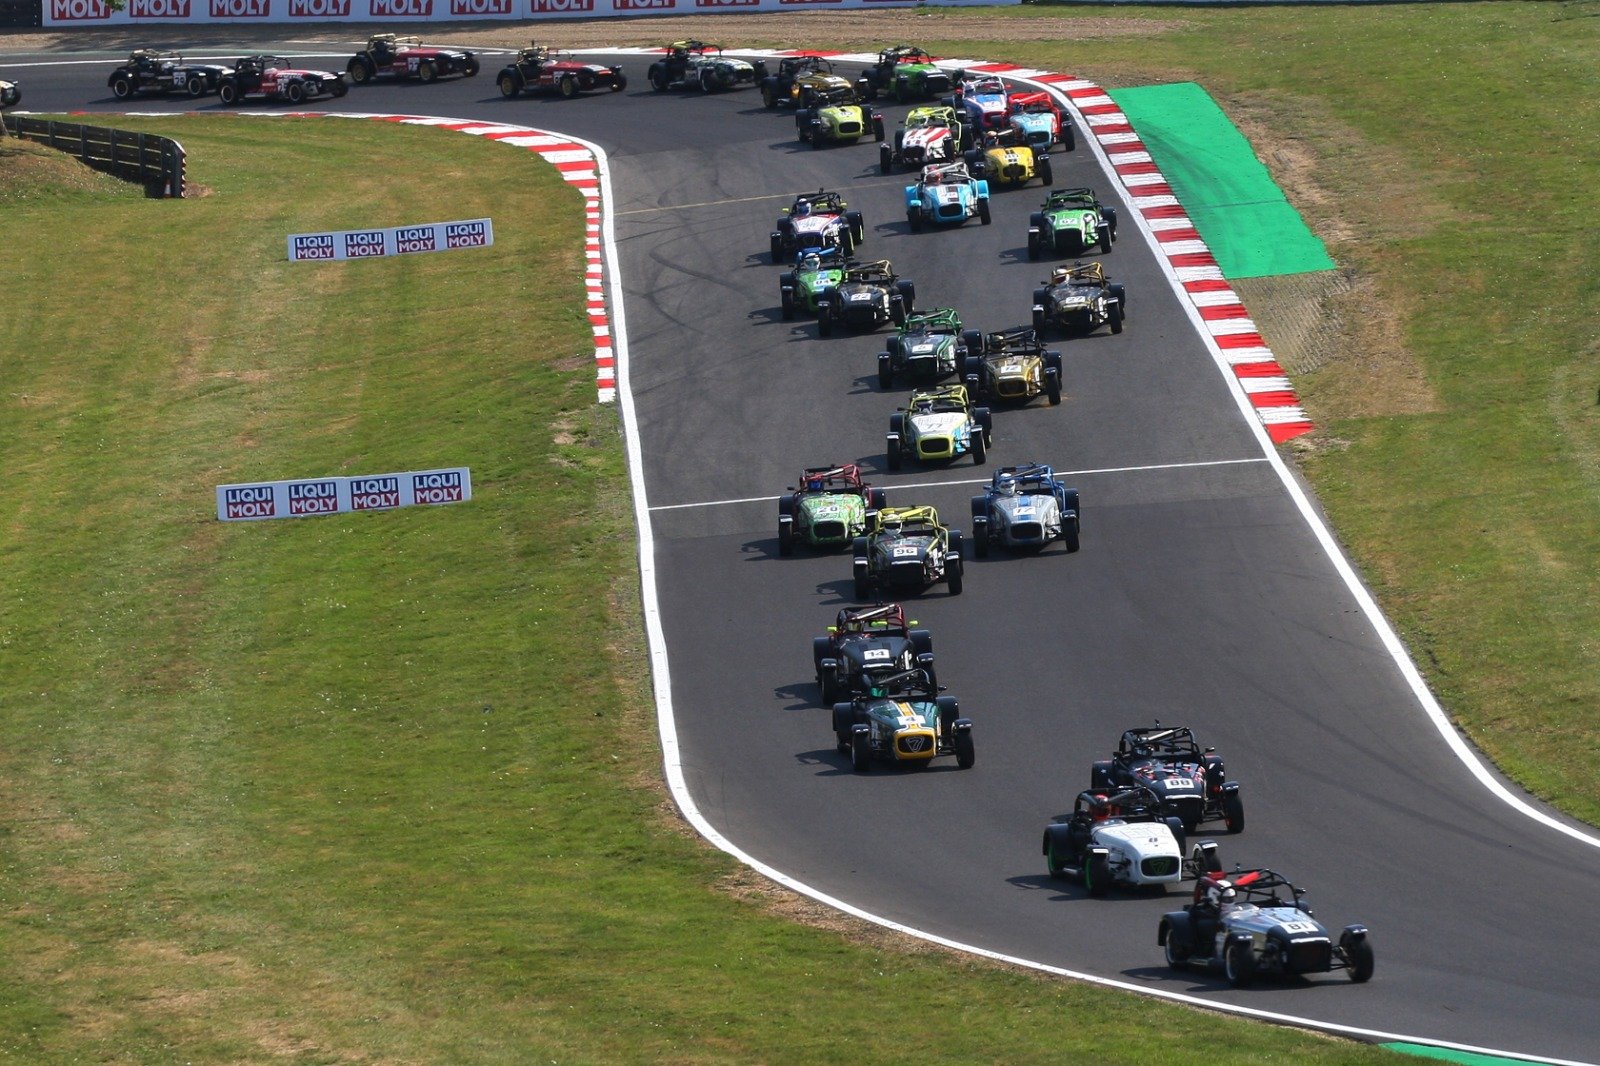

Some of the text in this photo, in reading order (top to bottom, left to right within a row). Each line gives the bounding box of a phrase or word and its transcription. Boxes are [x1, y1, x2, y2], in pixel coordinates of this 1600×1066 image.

[133, 0, 187, 16] MOLY
[212, 0, 267, 15] MOLY
[291, 0, 346, 15] MOLY
[373, 0, 427, 14] MOLY
[398, 228, 433, 241] LIQUI
[448, 223, 483, 236] LIQUI
[297, 236, 332, 248] LIQUI
[347, 233, 382, 245] LIQUI
[399, 239, 434, 252] MOLY
[448, 234, 484, 248] MOLY
[297, 247, 333, 259] MOLY
[348, 244, 383, 256] MOLY
[352, 479, 396, 494] LIQUI
[415, 473, 459, 488] LIQUI
[228, 488, 272, 503] LIQUI
[290, 483, 334, 498] LIQUI
[416, 487, 461, 503] MOLY
[291, 498, 336, 513] MOLY
[353, 492, 398, 508] MOLY
[229, 502, 273, 517] MOLY
